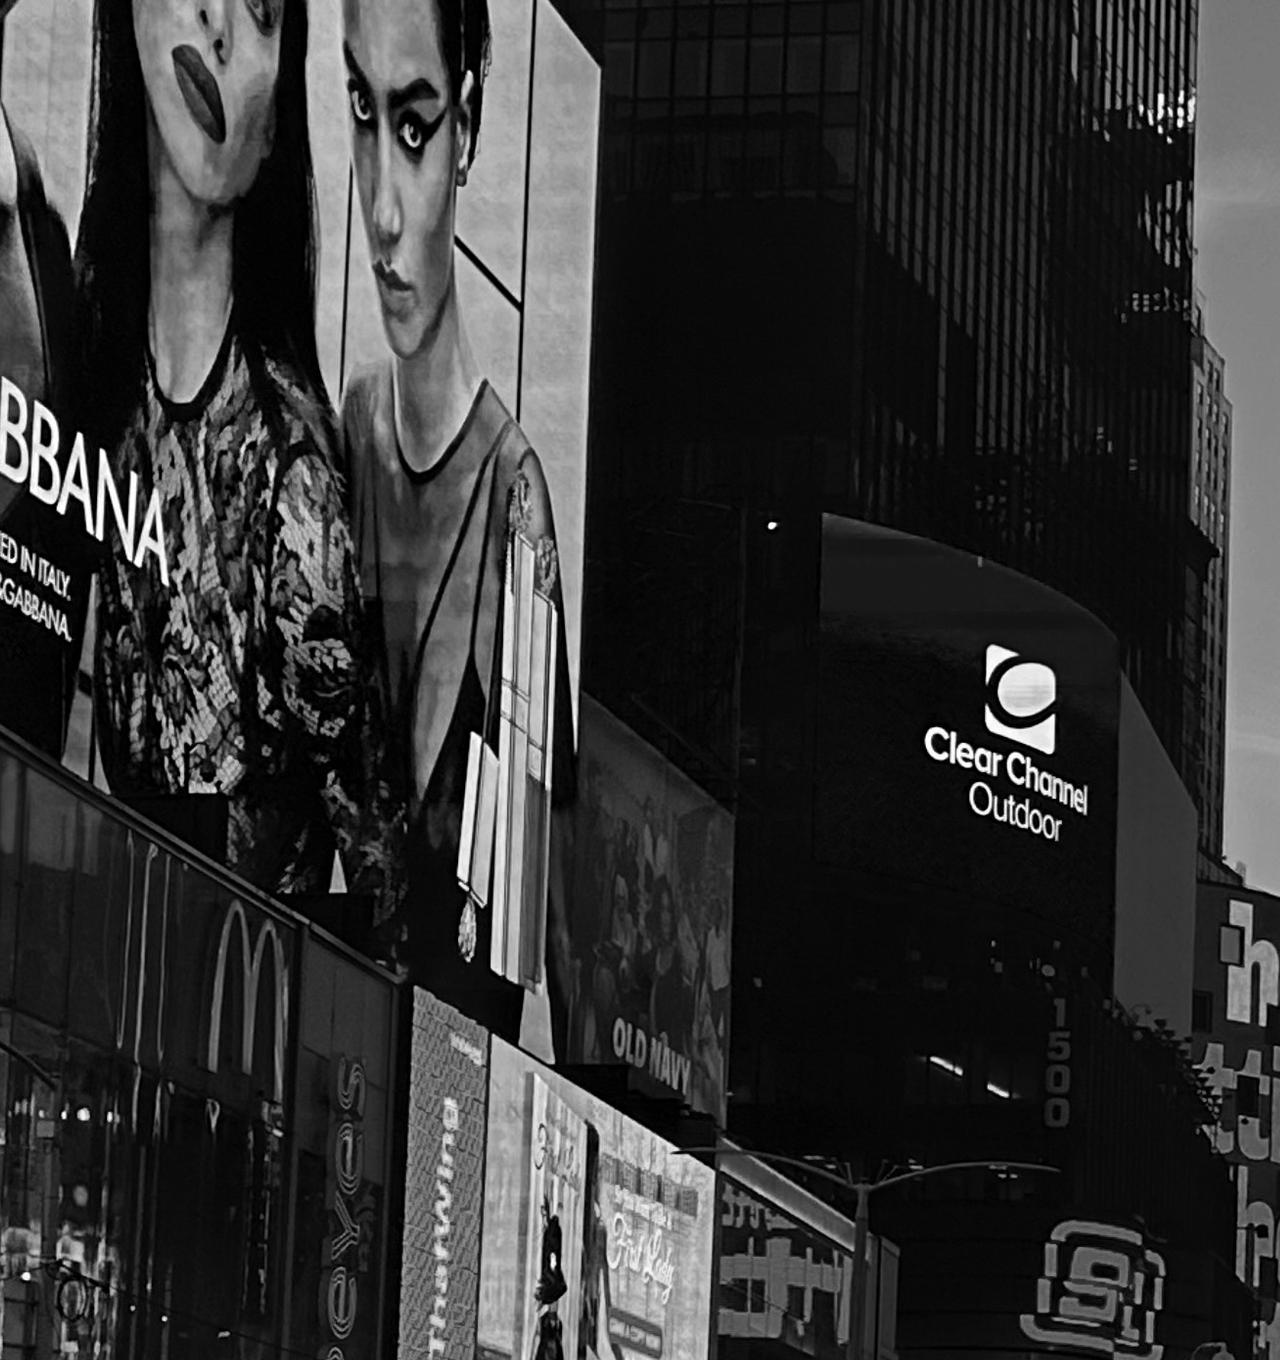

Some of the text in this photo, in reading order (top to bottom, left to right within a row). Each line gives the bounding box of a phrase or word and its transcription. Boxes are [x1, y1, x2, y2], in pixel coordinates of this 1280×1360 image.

[924, 727, 1089, 817] Clear Channel
[969, 783, 1063, 843] Outdoor
[613, 1017, 692, 1096] OLD NAVY
